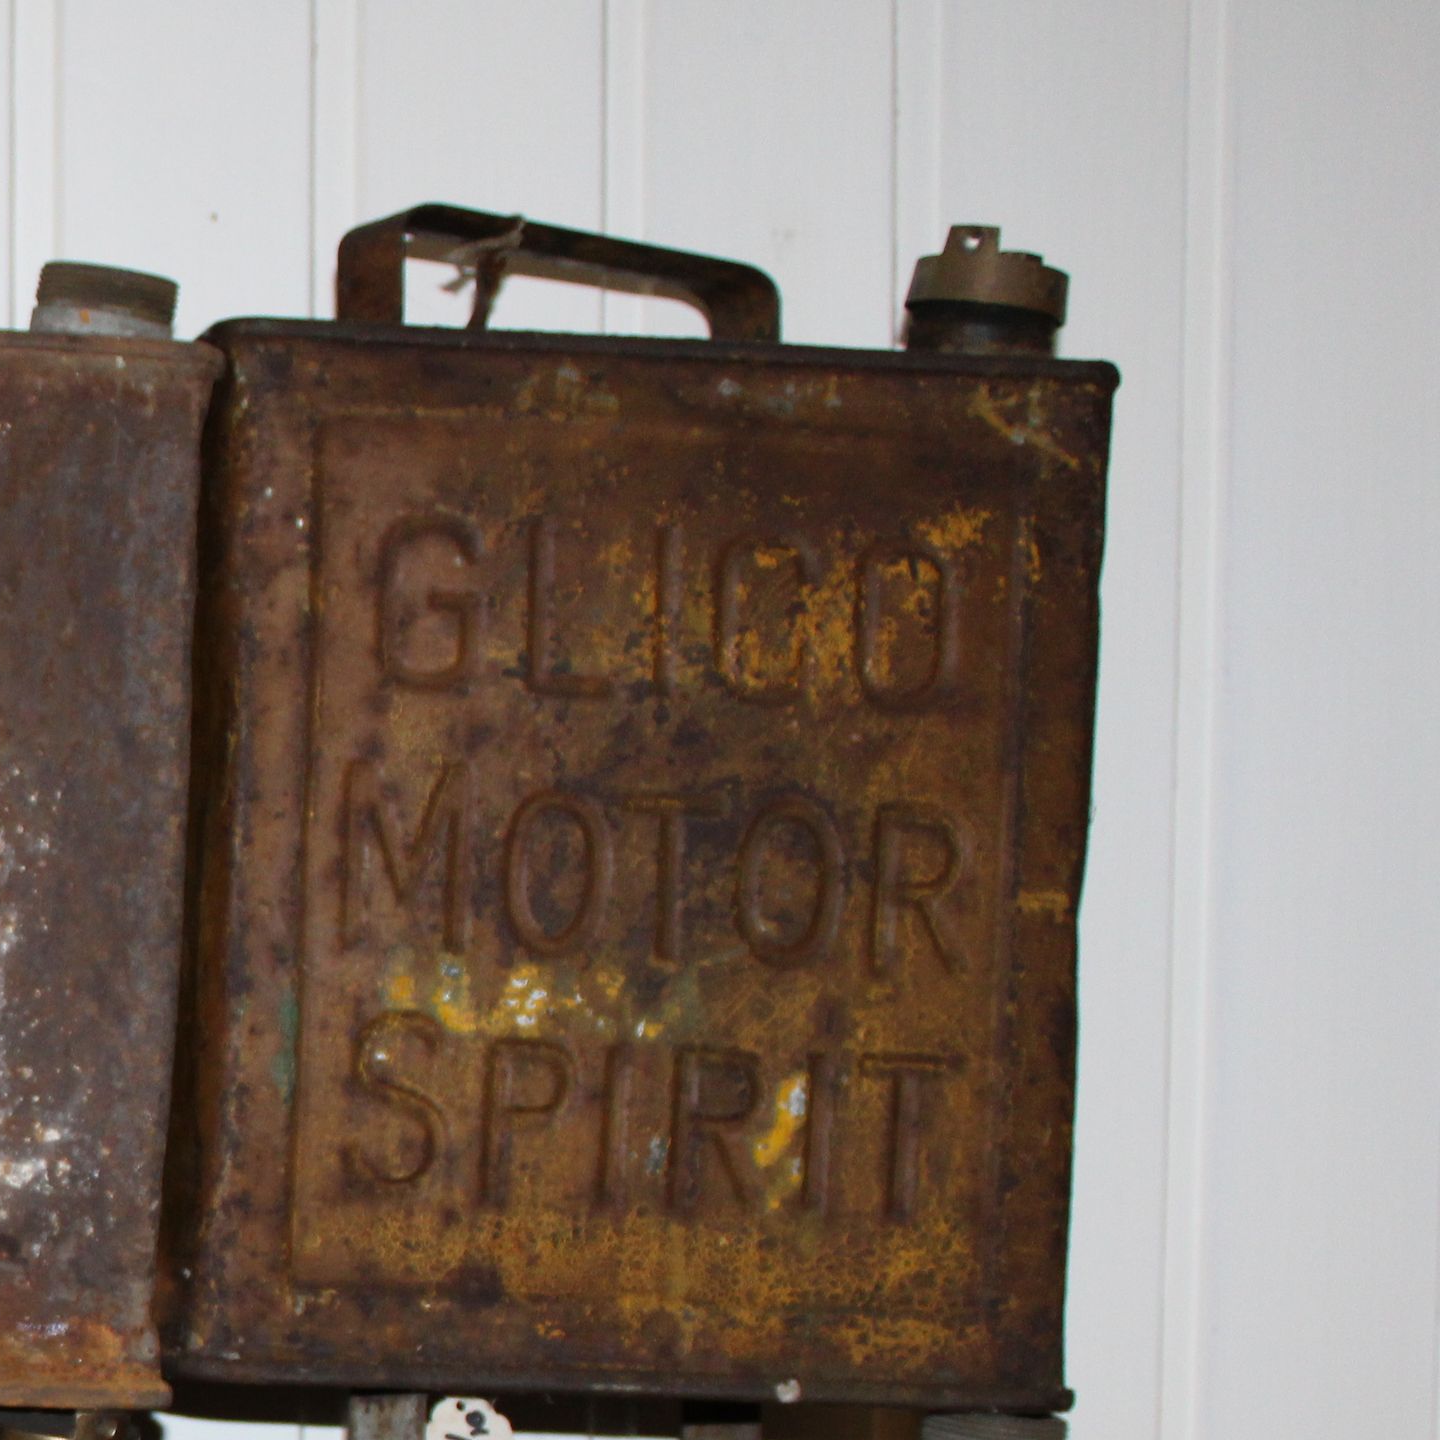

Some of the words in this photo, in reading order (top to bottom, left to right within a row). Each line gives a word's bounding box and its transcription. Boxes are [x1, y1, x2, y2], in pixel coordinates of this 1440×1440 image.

[375, 511, 956, 712] GLICO
[334, 758, 972, 980] MOTOR
[338, 1008, 966, 1217] SPIRIT
